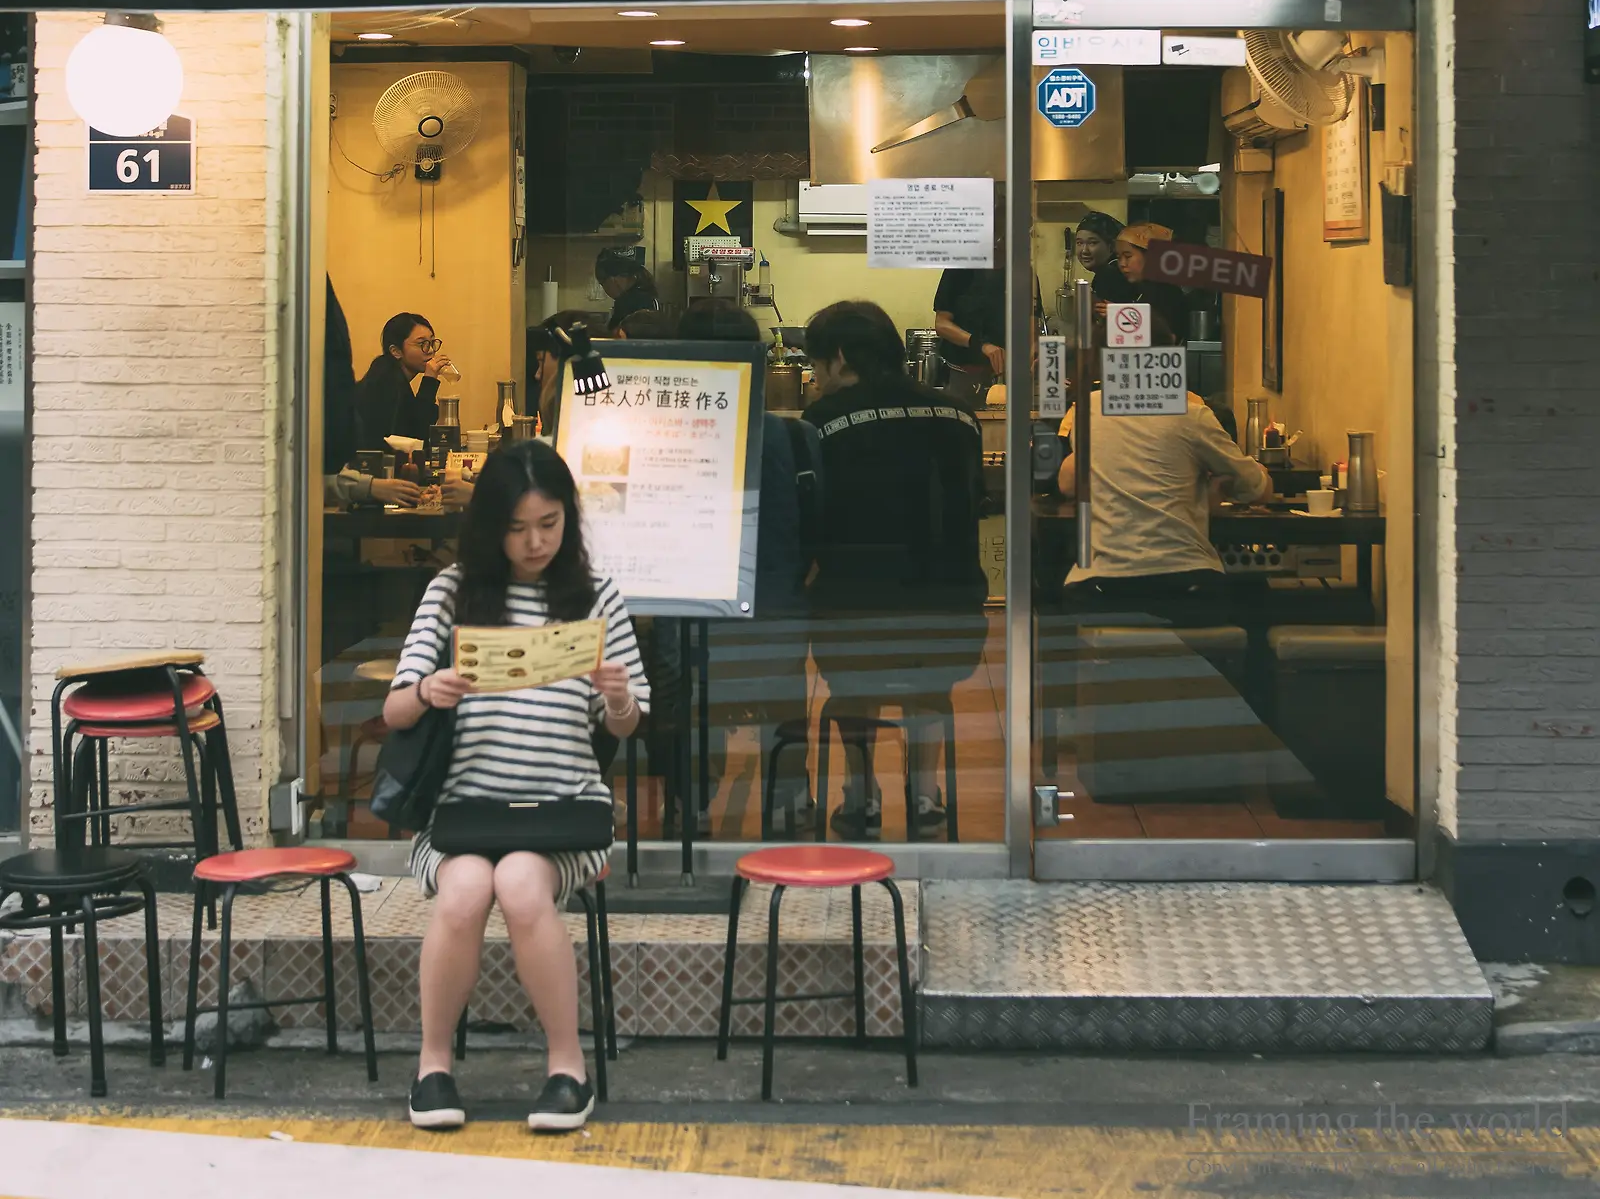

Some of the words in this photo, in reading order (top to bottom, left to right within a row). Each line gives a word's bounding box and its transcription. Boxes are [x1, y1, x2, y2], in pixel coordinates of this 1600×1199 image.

[1046, 88, 1086, 108] ADT
[116, 148, 160, 183] 61
[1160, 250, 1258, 288] OPEN
[1045, 341, 1060, 399] 당기시오
[1134, 353, 1182, 369] 12:00
[1134, 373, 1182, 389] 11:00
